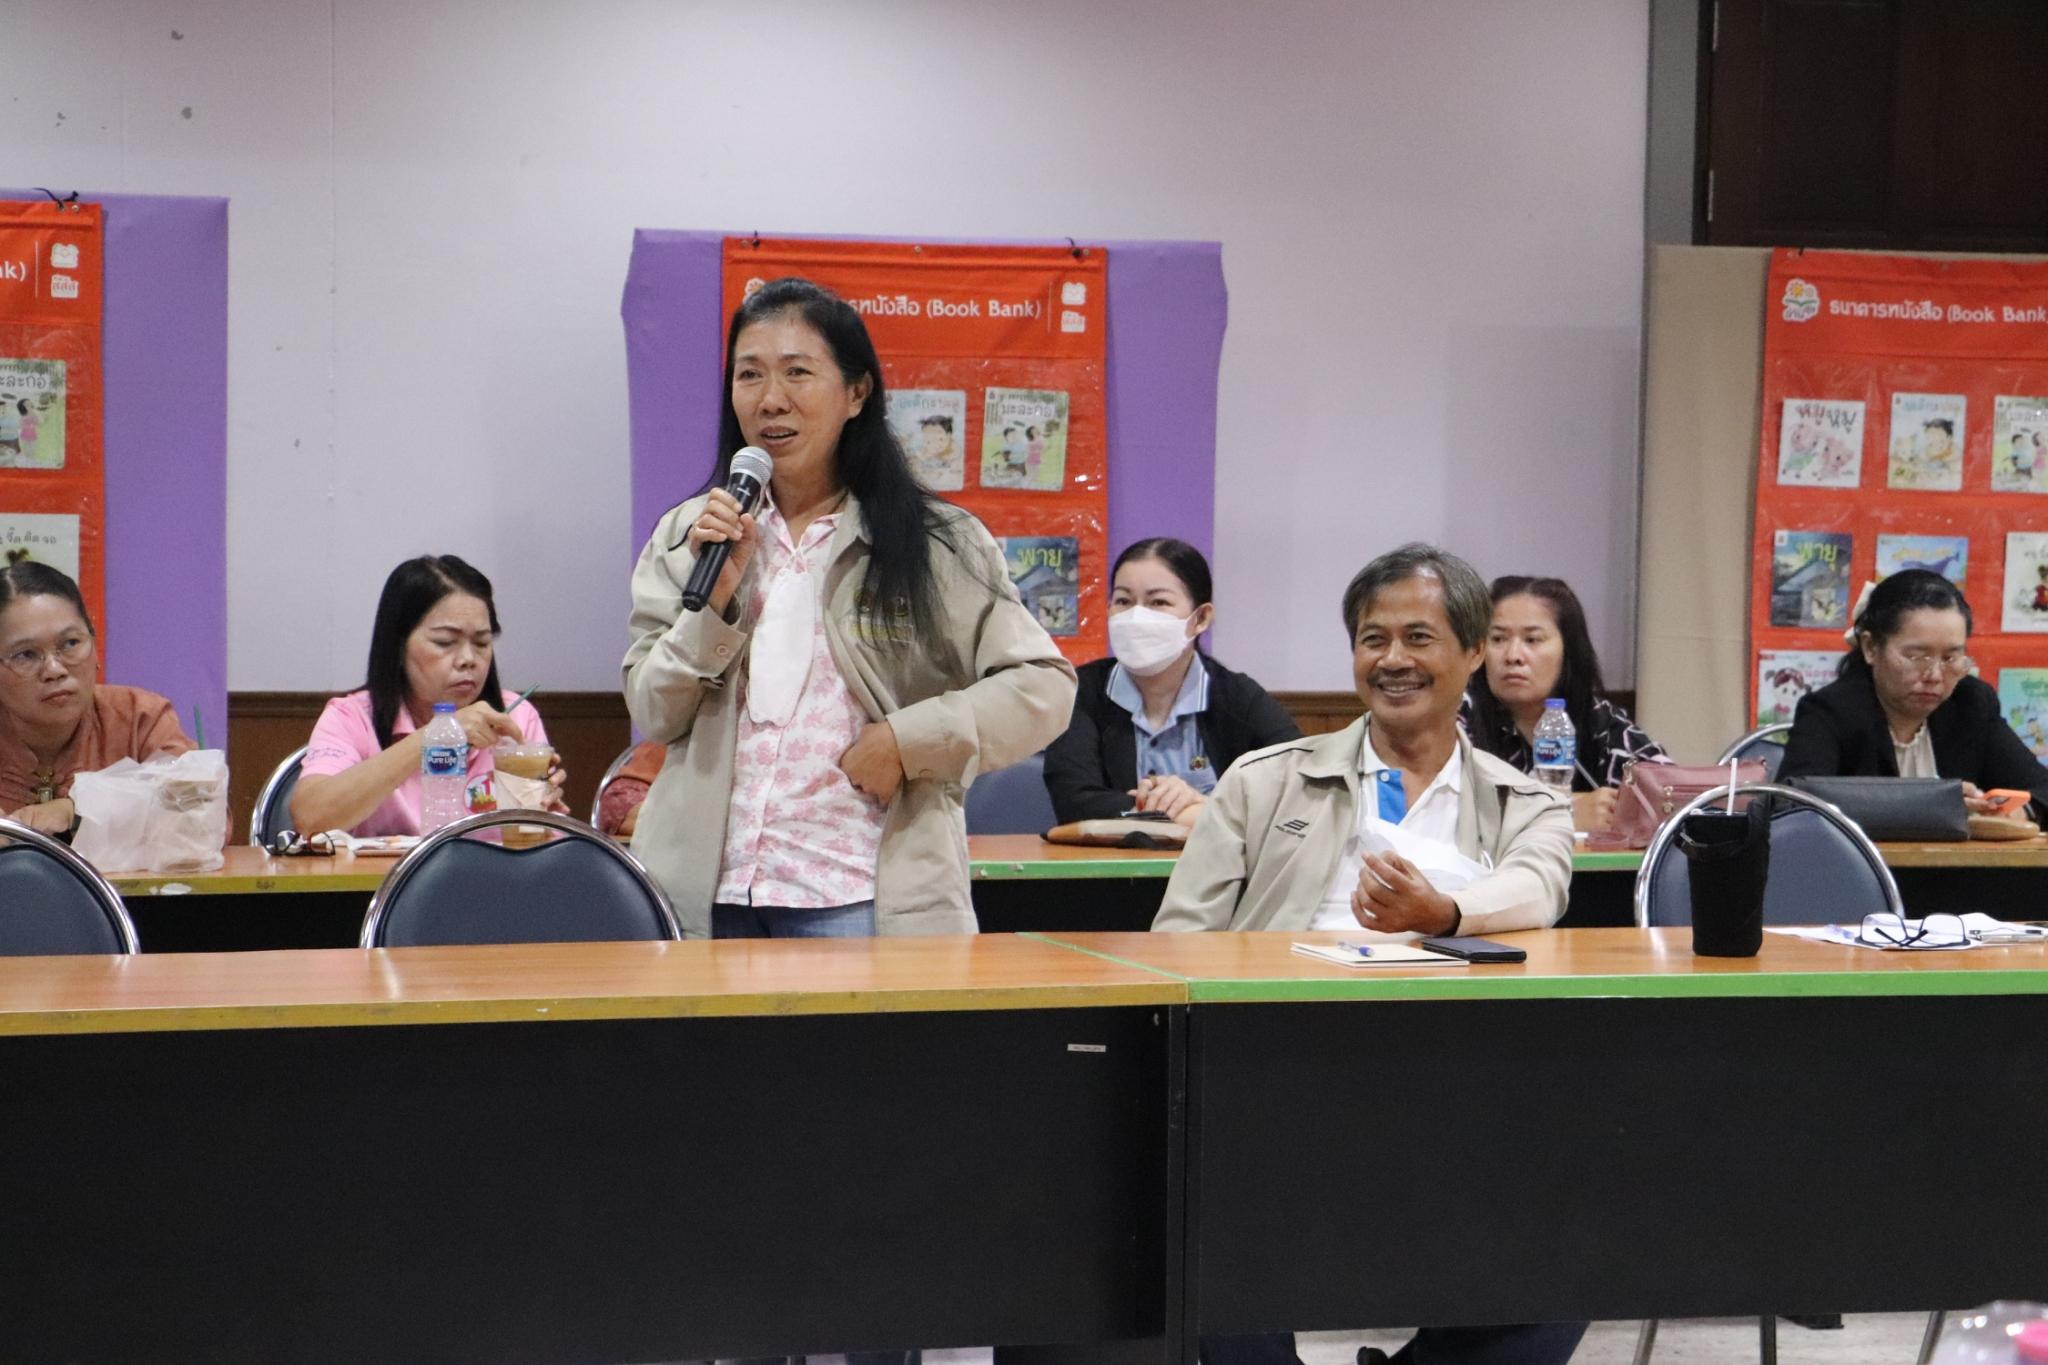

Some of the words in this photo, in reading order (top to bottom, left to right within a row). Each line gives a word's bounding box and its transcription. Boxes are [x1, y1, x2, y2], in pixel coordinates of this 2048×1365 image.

[0, 260, 27, 283] k)
[926, 299, 981, 320] (Book
[988, 299, 1042, 321] Bank)
[1947, 303, 1995, 324] (Book
[2002, 305, 2048, 324] Bank
[1017, 547, 1063, 576] พายุ
